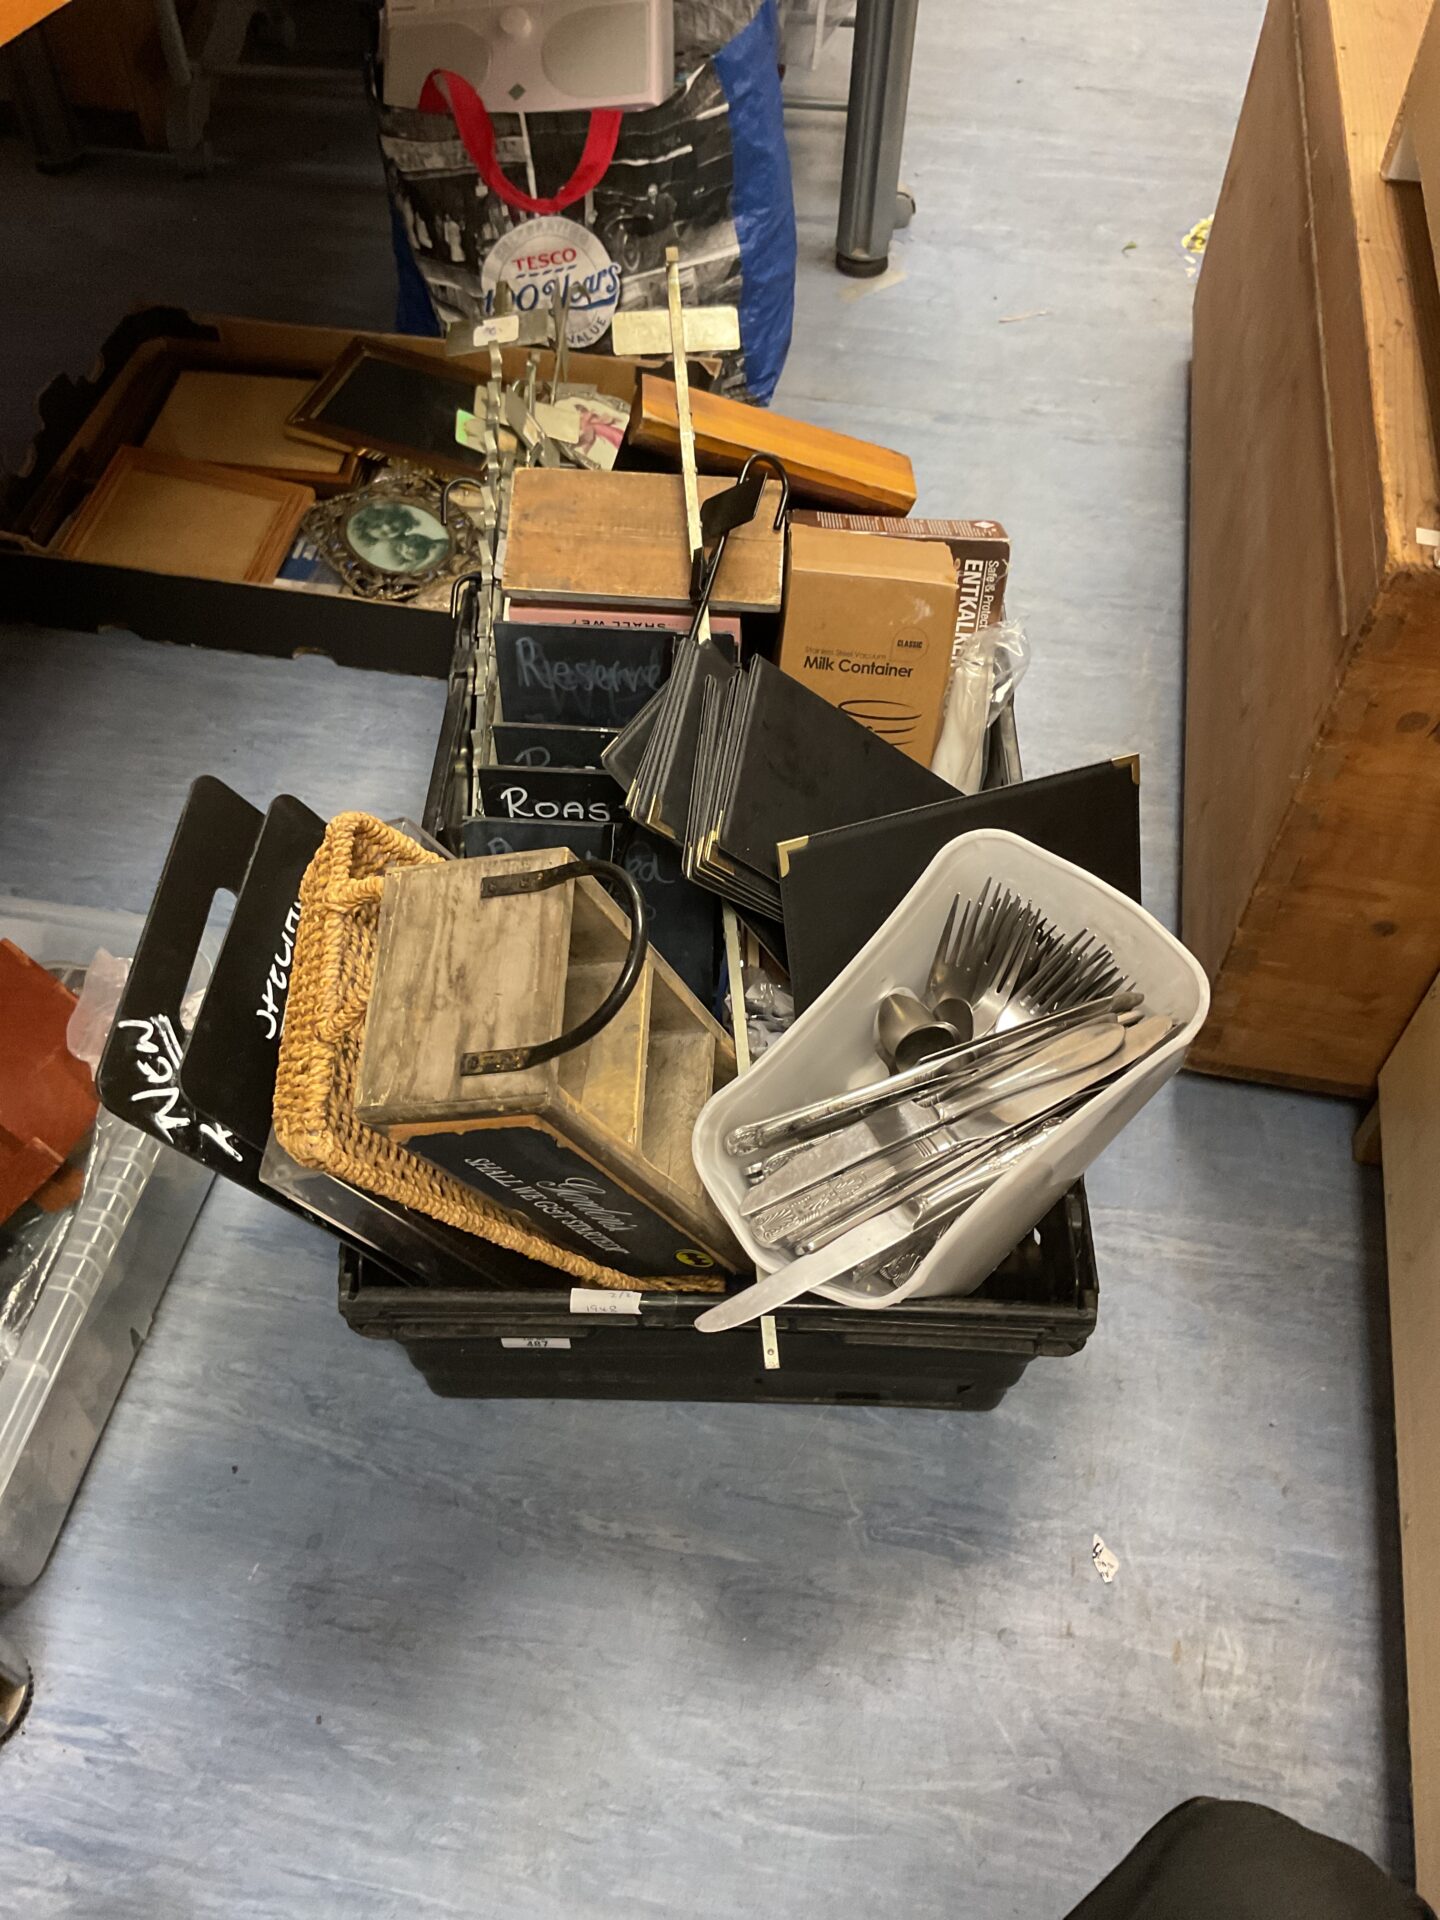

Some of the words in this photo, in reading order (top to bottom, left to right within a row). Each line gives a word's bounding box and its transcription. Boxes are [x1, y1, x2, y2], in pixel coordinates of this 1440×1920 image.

[512, 247, 577, 271] TESCO
[567, 319, 606, 343] VALUE
[986, 560, 999, 583] Safe
[985, 584, 996, 592] &
[979, 594, 994, 628] Protect
[897, 640, 923, 649] CLASSIC
[803, 656, 835, 671] Milk
[838, 659, 914, 678] Container
[500, 787, 624, 822] ROAS
[464, 1158, 524, 1187] SHALL
[511, 1186, 548, 1201] WE
[536, 1177, 638, 1231] Gordon's
